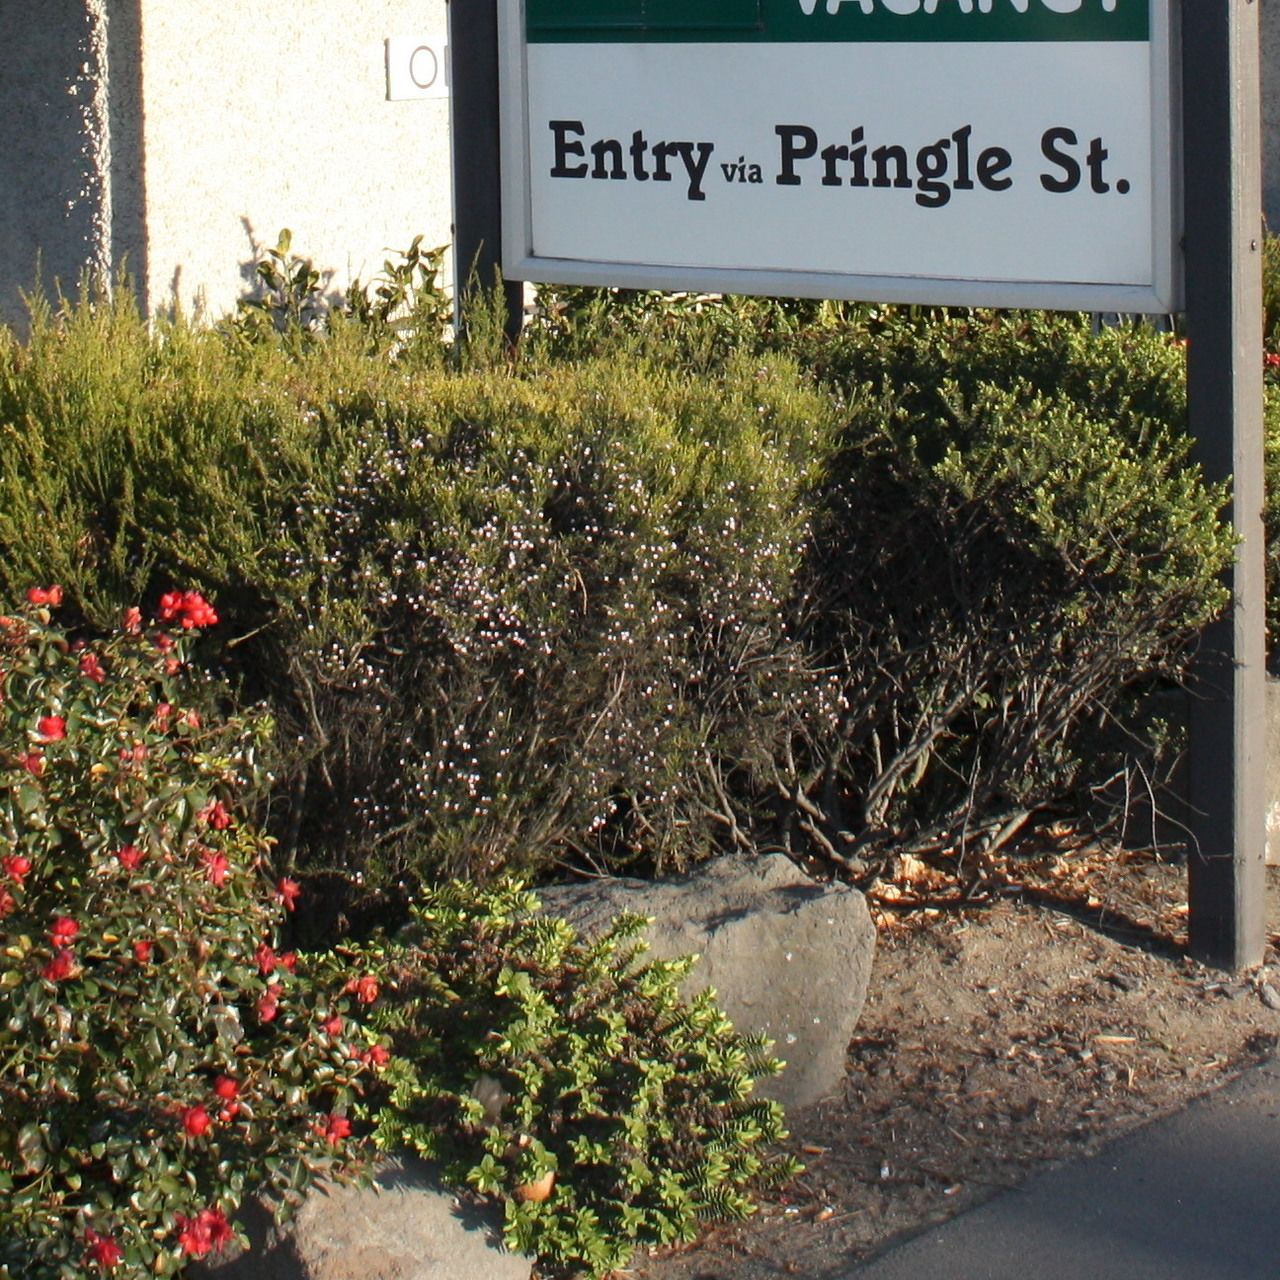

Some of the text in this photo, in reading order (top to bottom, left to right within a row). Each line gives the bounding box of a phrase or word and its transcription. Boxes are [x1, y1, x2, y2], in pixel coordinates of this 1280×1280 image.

[549, 119, 1131, 209] Entry via Pringle St.
